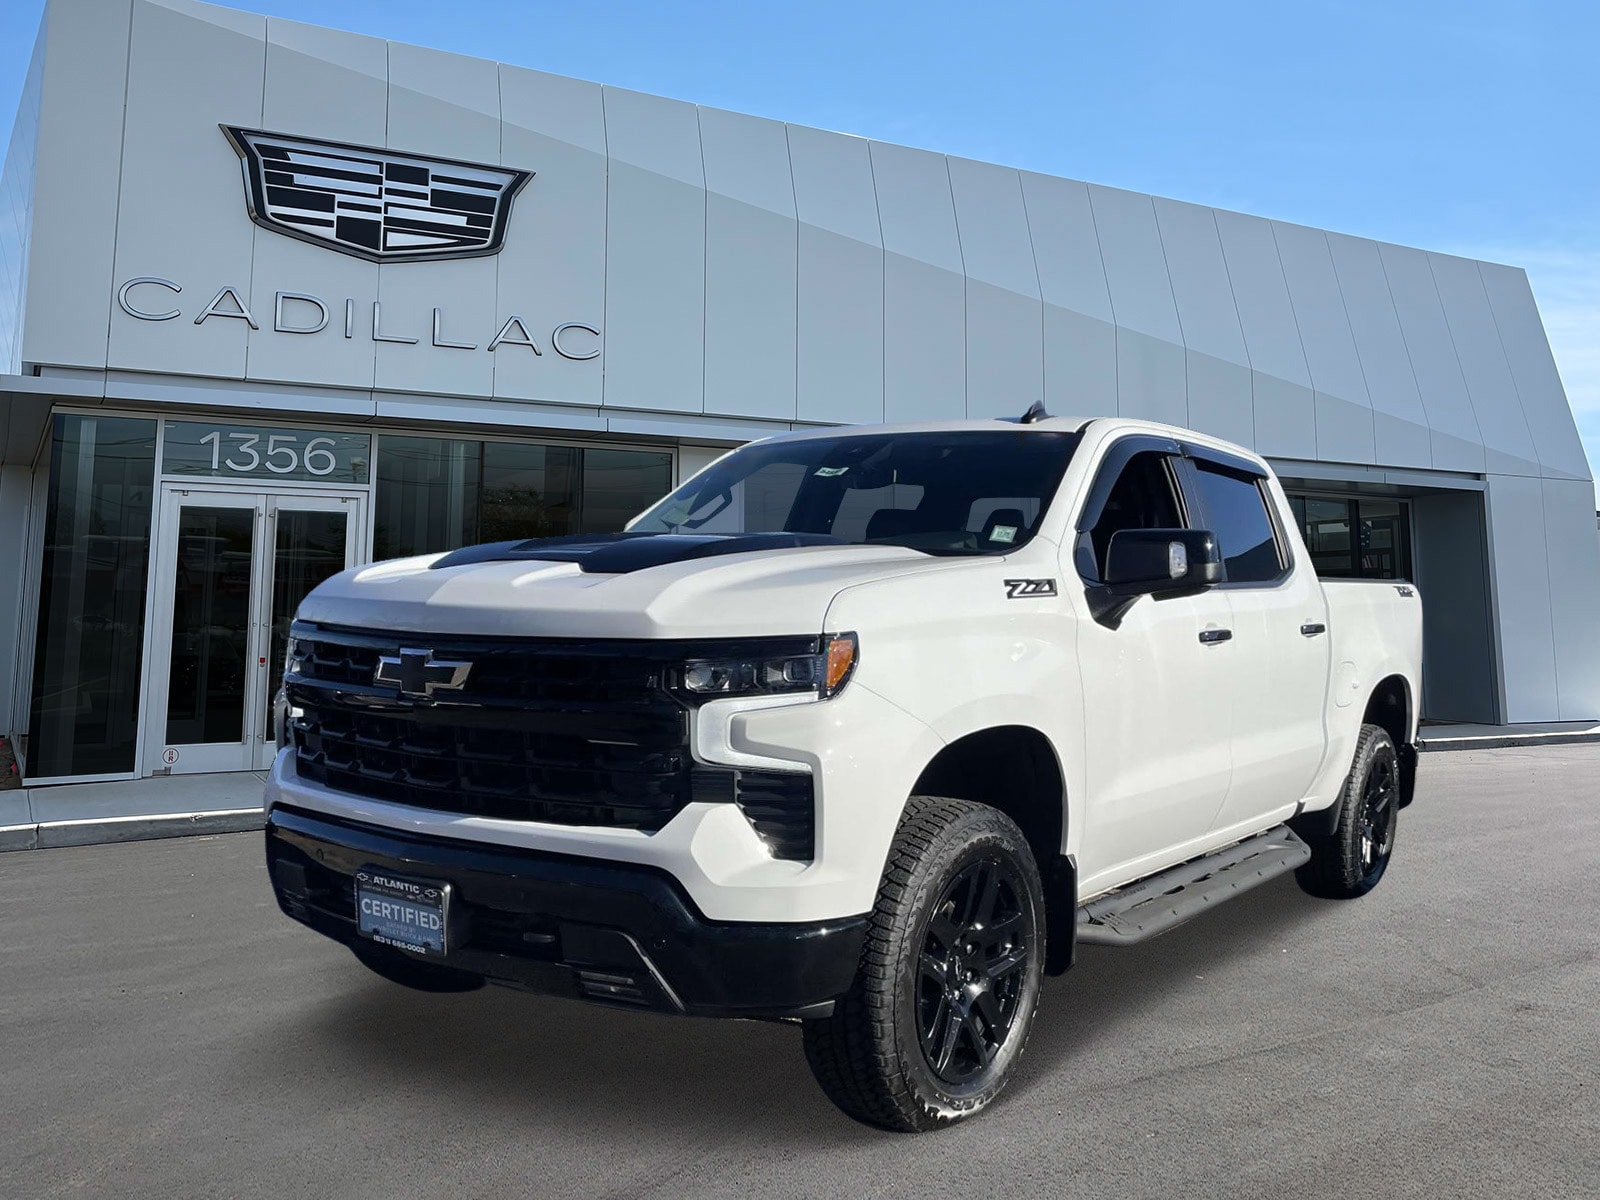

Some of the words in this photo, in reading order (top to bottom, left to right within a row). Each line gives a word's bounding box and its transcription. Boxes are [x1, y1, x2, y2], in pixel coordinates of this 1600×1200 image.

[117, 276, 601, 361] CADILLAC
[200, 431, 337, 476] 1356
[373, 876, 420, 894] ATLANTIC
[361, 898, 440, 930] CERTIFIED
